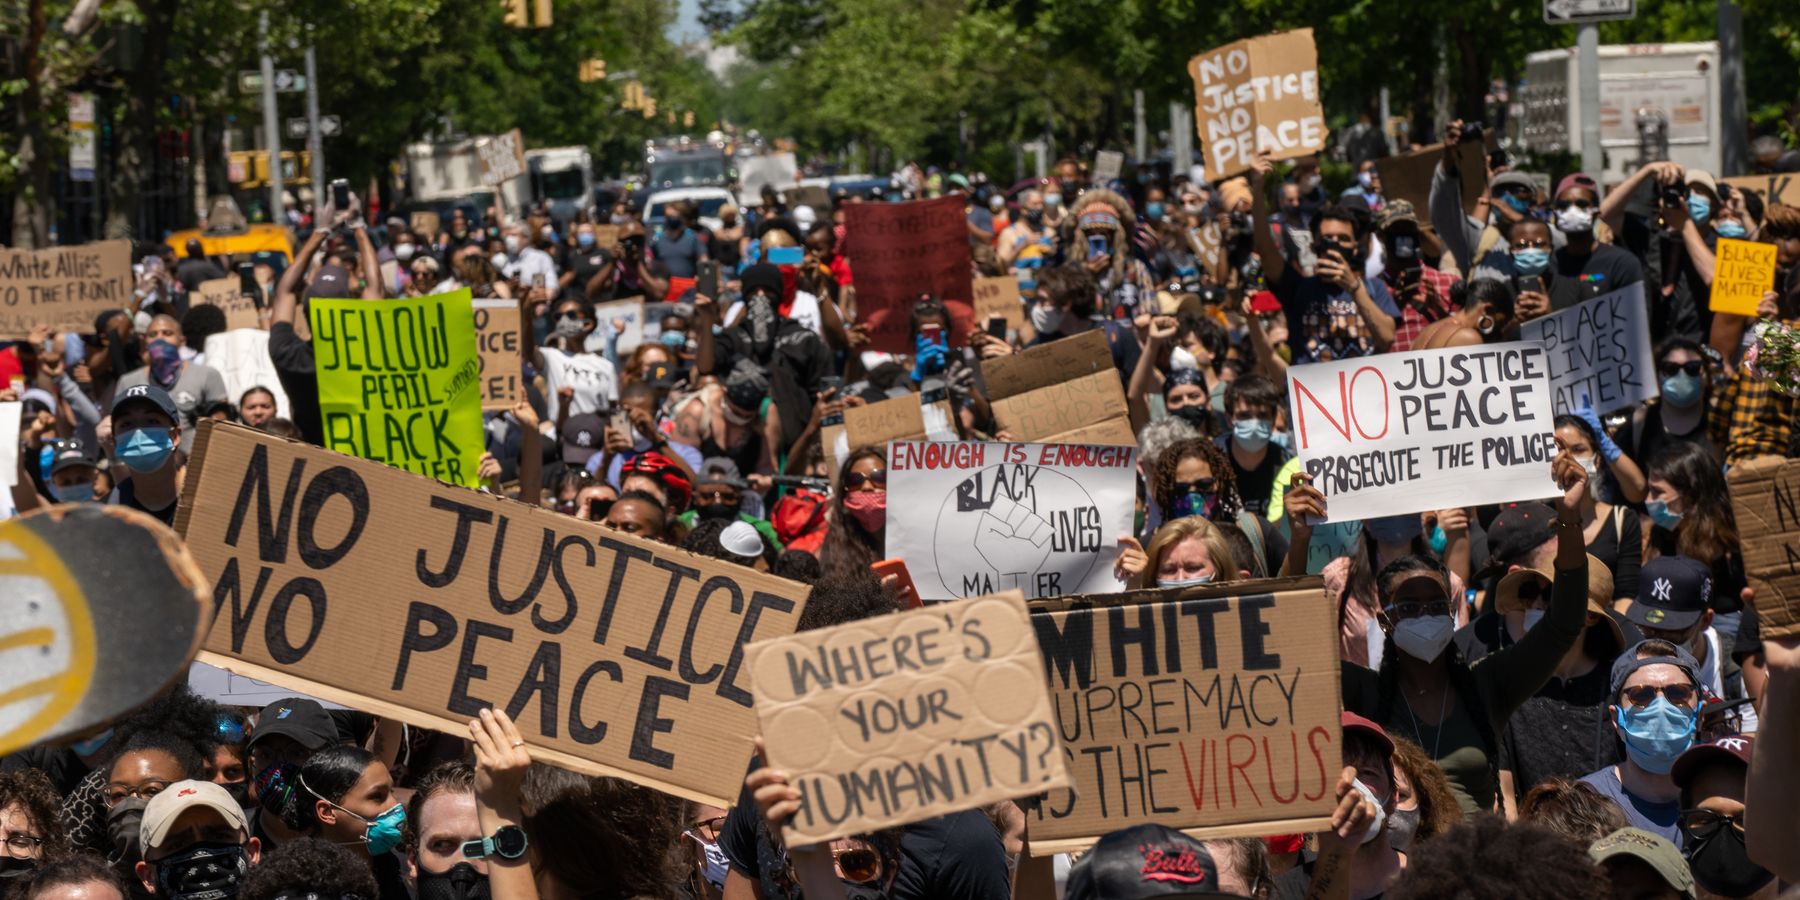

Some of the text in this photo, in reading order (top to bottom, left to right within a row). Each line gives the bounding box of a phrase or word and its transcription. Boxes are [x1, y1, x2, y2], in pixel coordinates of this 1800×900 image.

[1200, 49, 1248, 85] NO
[1203, 70, 1318, 113] JUSTICE
[1207, 108, 1250, 142] NO
[1212, 117, 1321, 175] PEACE
[55, 251, 102, 279] Allies
[1719, 262, 1768, 283] LIVES
[1722, 244, 1774, 268] BLACK
[27, 284, 62, 305] THE
[474, 308, 489, 330] O
[316, 302, 449, 372] YELLOW
[1541, 296, 1627, 351] BLACK
[1547, 329, 1627, 381] LIVES
[361, 373, 443, 410] PERIL
[1292, 348, 1544, 449] NO JUSTICE
[1400, 384, 1535, 435] PEACE
[1555, 362, 1642, 414] ATTER
[326, 408, 462, 463] BLACK
[855, 408, 913, 436] BLACK
[891, 443, 1132, 470] ENOUGH IS ENOUGH
[1306, 432, 1556, 497] PROSECUTE THE POLICE
[957, 463, 1041, 514] BLACK
[1050, 505, 1101, 553] LIVES
[224, 443, 796, 708] NO JUSTICE
[210, 556, 691, 770] NO PEACE
[785, 613, 992, 696] WHERE'S
[1030, 593, 1281, 689] WHITE
[841, 688, 963, 742] YOUR
[1055, 667, 1301, 743] UPREMACY
[1081, 742, 1180, 818] THE
[1179, 725, 1332, 811] VIRUS
[1140, 848, 1200, 874] Bulls
